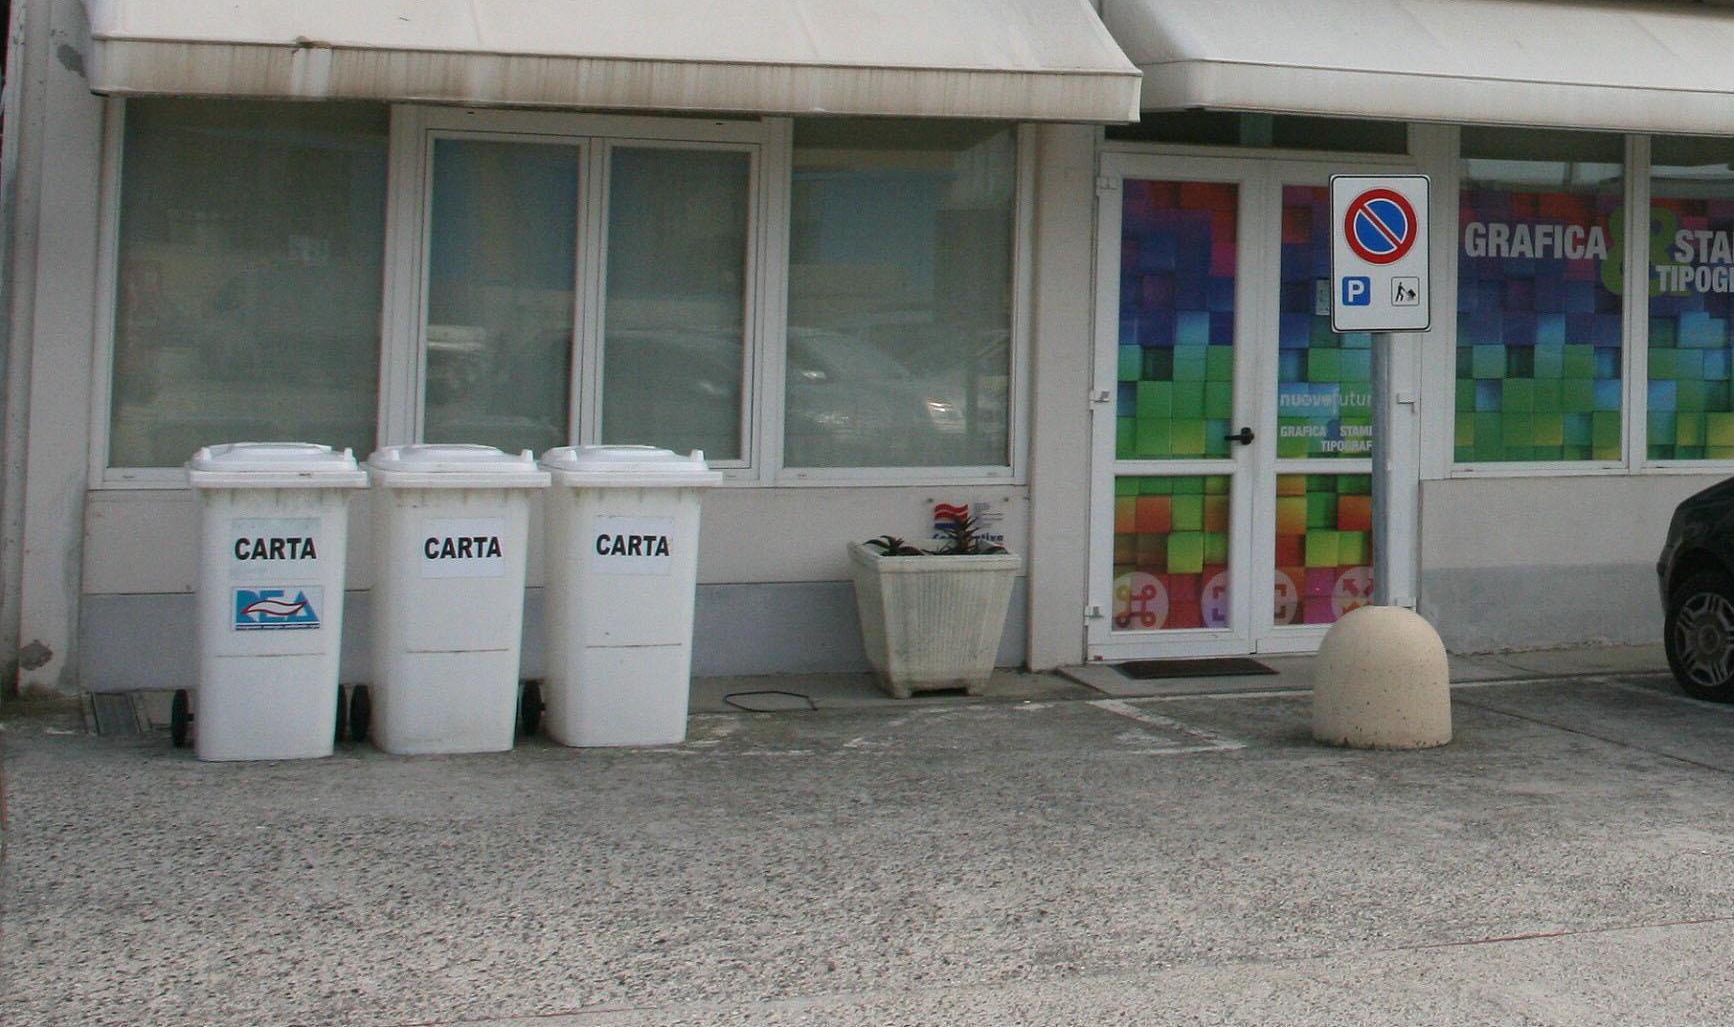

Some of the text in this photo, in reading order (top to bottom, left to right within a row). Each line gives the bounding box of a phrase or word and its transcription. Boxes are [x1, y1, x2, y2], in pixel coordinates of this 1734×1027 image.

[1464, 222, 1608, 260] GRAFICA
[1347, 279, 1365, 303] P
[1280, 425, 1373, 438] GRAFICA STAM
[1320, 440, 1373, 453] TIPOGRAF
[234, 537, 317, 561] CARTA
[424, 536, 502, 560] CARTA
[596, 534, 670, 557] CARTA
